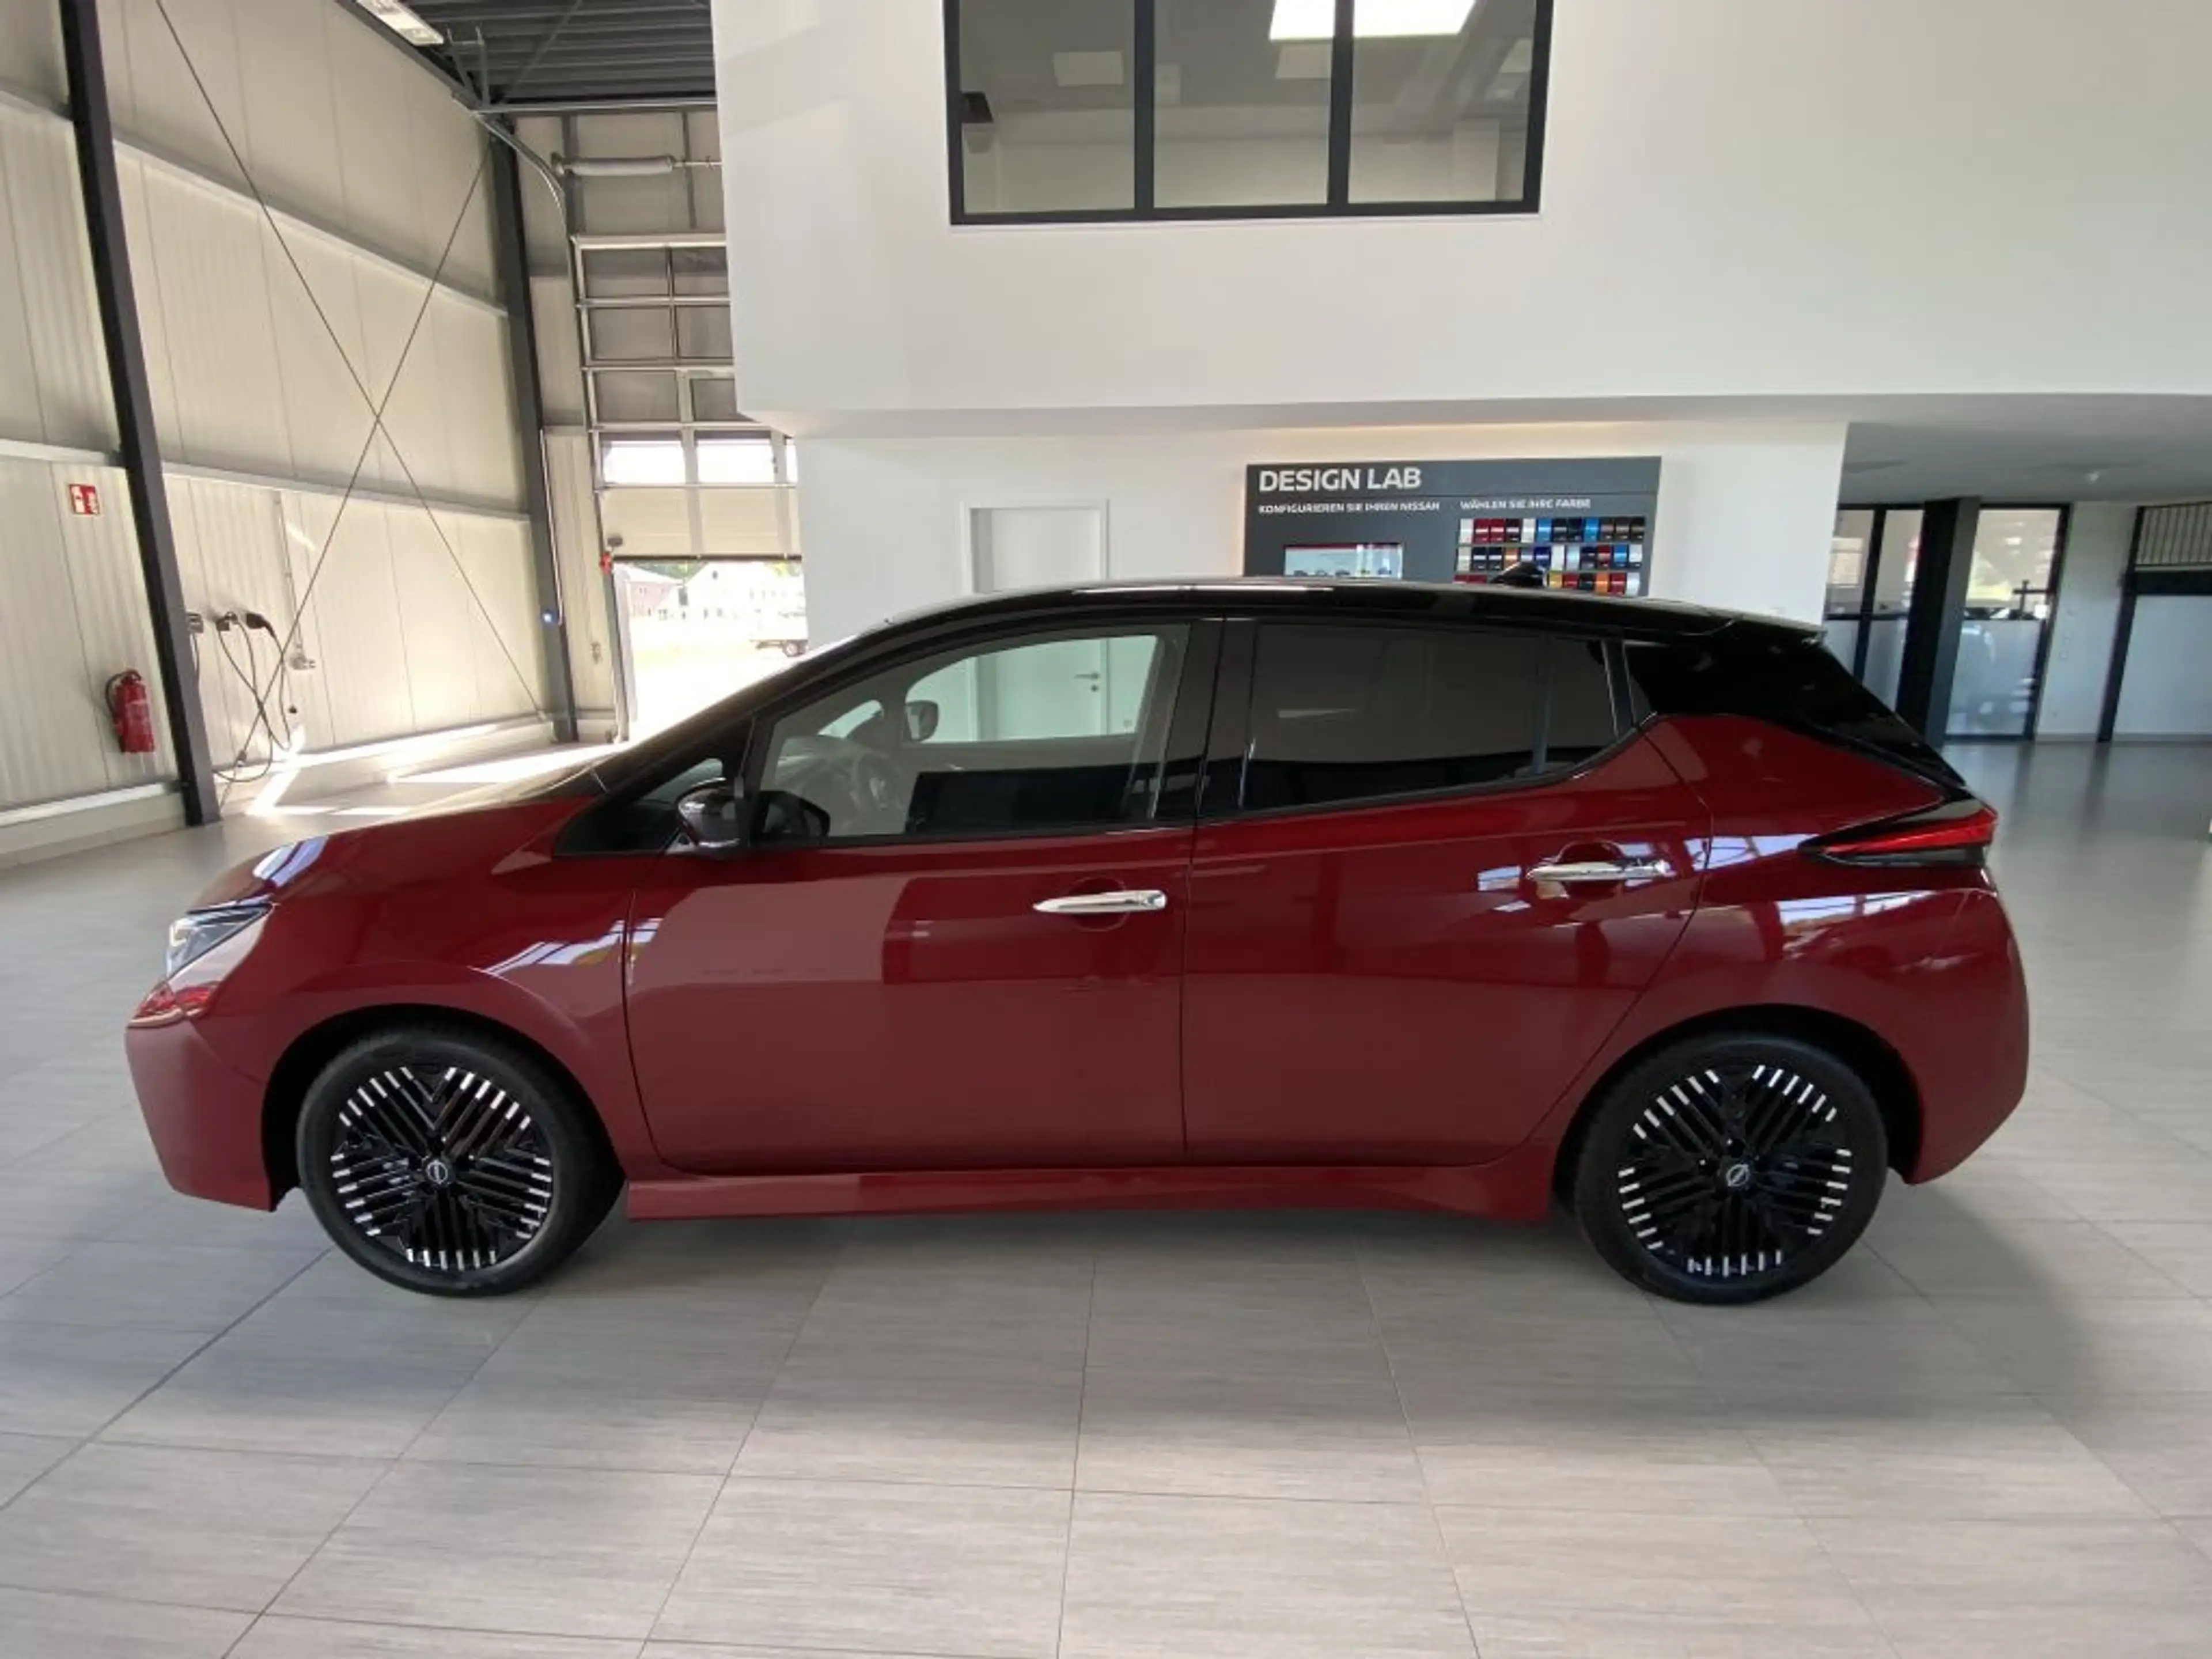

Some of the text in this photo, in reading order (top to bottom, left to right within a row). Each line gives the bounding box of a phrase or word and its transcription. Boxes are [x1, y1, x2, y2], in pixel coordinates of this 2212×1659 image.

[1259, 466, 1422, 492] DESIGN LAB
[1259, 501, 1440, 514] KONFIGURIEREN SIE IHREN NISSAN
[1508, 499, 1527, 509] SIE
[1555, 498, 1591, 509] FARBE
